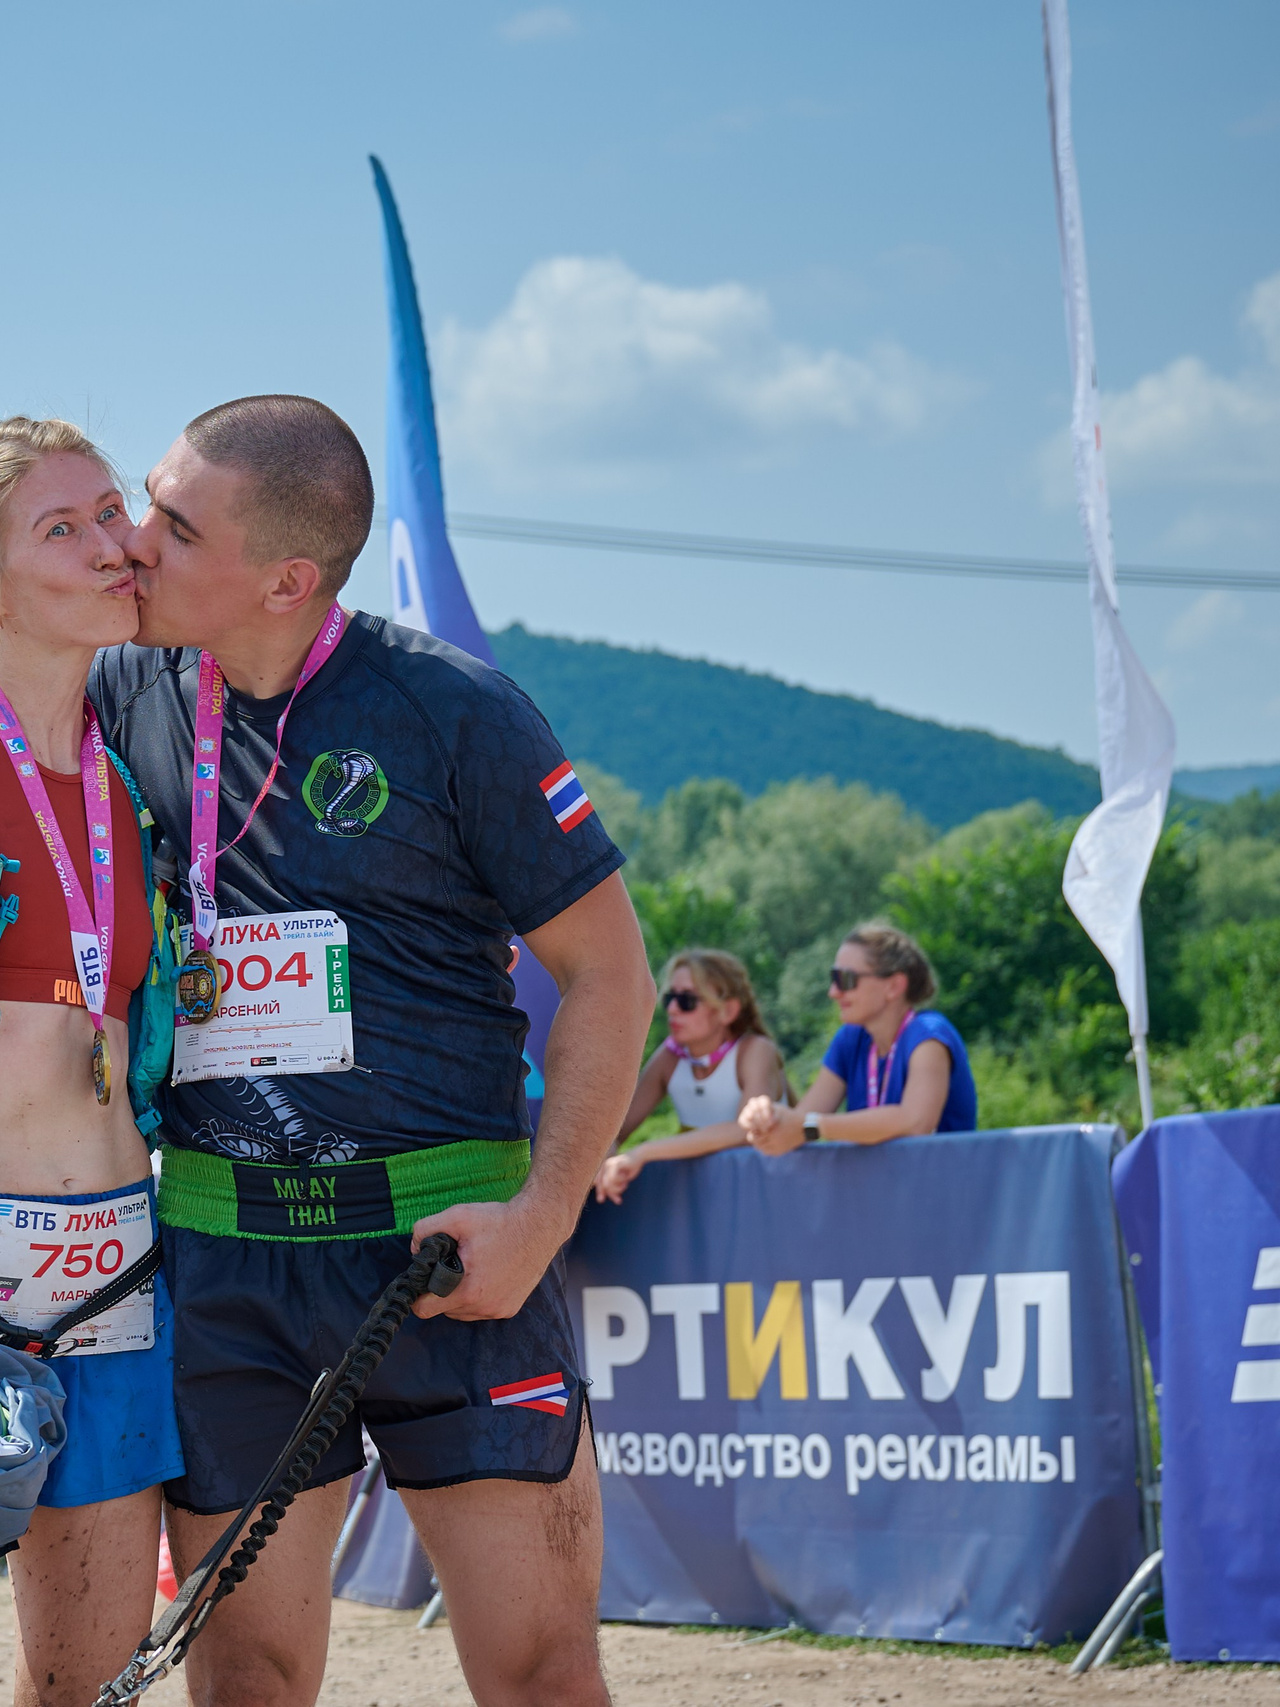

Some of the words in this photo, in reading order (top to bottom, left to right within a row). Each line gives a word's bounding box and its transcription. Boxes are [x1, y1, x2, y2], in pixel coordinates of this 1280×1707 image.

[211, 664, 223, 715] УЛЬТРА
[91, 720, 103, 753] ЛУКА
[95, 753, 109, 802] УЛЬТРА
[34, 810, 60, 860] УЛЬТРА
[55, 860, 73, 898] ЛУКА
[193, 879, 216, 911] ВТБ
[221, 922, 281, 946] ЛУКА
[283, 918, 333, 931] УЛЬТРА
[283, 932, 305, 940] ТРЕЙЛ
[314, 930, 334, 938] БАЙК
[80, 946, 101, 987] ВТБ
[332, 949, 345, 1008] ТРЕЙЛ
[212, 999, 280, 1019] АРСЕНИЙ
[273, 1176, 336, 1200] MUAY
[15, 1209, 57, 1231] ВТБ
[64, 1208, 117, 1232] ЛУКА
[118, 1201, 145, 1216] УЛЬТРА
[285, 1204, 337, 1226] THAI
[29, 1239, 124, 1279] 750
[582, 1271, 1072, 1402] РТИКУЛ
[595, 1431, 831, 1487] изводство
[845, 1431, 1076, 1495] рекламы
